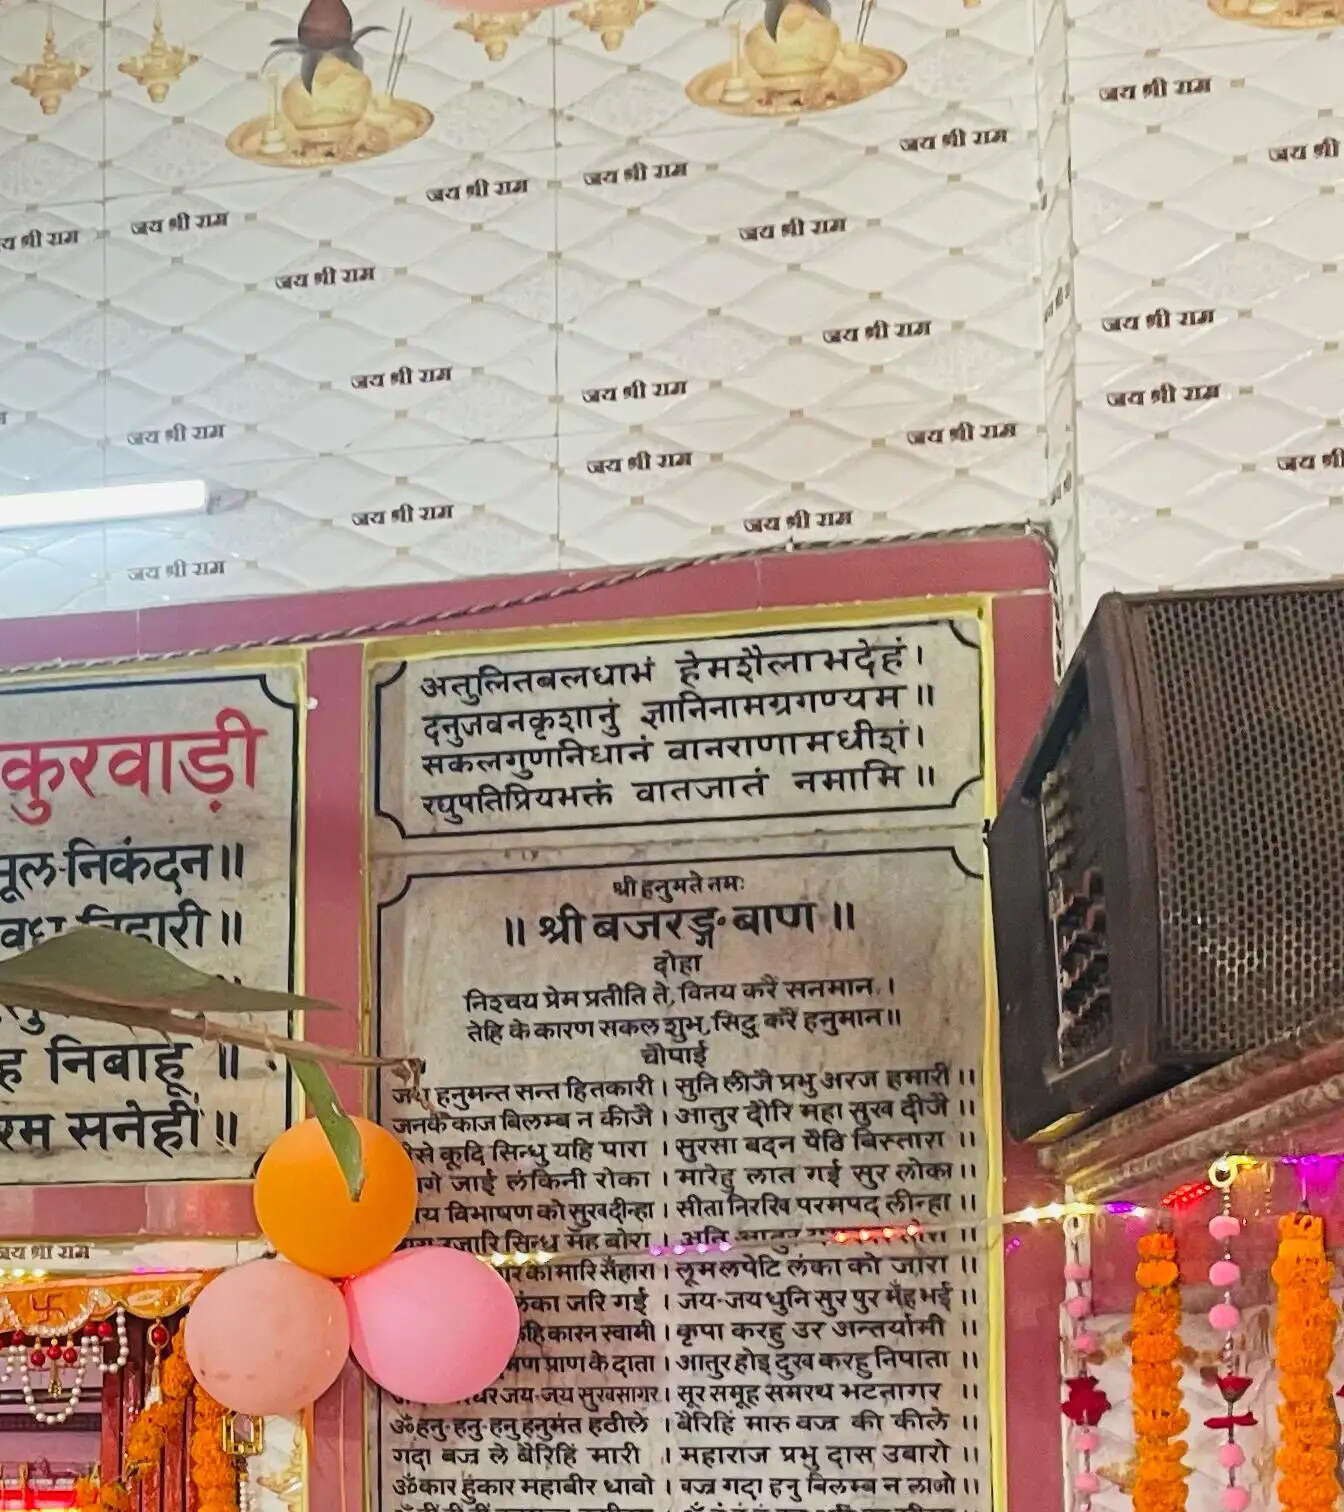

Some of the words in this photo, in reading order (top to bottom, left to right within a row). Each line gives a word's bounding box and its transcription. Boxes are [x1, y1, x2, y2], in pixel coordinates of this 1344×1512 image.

[1100, 85, 1136, 101] जय
[1143, 78, 1167, 98] श्री
[1176, 78, 1211, 94] राम
[900, 136, 936, 151] जय
[942, 129, 965, 147] श्री
[974, 129, 1007, 144] राम
[584, 170, 617, 185] जय
[624, 162, 647, 181] श्री
[654, 163, 688, 178] राम
[21, 230, 41, 247] श्री
[48, 230, 79, 246] राम
[823, 328, 859, 343] जय
[865, 320, 888, 339] श्री
[896, 321, 931, 337] राम
[1107, 391, 1145, 406] जय
[1151, 384, 1176, 403] श्री
[1183, 385, 1220, 401] राम
[792, 759, 905, 792] नमामि
[539, 903, 587, 944] श्री
[732, 903, 817, 936] बाण
[654, 950, 703, 978] दोहा
[543, 986, 579, 1009] प्रेम
[583, 982, 646, 1006] प्रतीति
[678, 980, 736, 1003] विनय
[467, 1020, 504, 1045] तेहि
[510, 1019, 530, 1040] के
[534, 1021, 594, 1040] कारण
[599, 1019, 659, 1037] सकल
[641, 1040, 708, 1068] चौपाई
[434, 1085, 510, 1111] हनुमन्त
[514, 1083, 560, 1101] सन्त
[563, 1073, 654, 1103] हितकारी
[675, 1071, 718, 1102] सुनि
[776, 1073, 818, 1098] प्रभु
[821, 1071, 879, 1089] अरज
[675, 1106, 739, 1132] आतुर
[799, 1103, 842, 1125] महा
[848, 1100, 894, 1127] सुख
[676, 1138, 737, 1163] सुरसा
[392, 1447, 430, 1471] गदा
[488, 1443, 508, 1465] ले
[586, 1442, 639, 1464] मारी
[679, 1447, 771, 1468] महाराज
[826, 1446, 876, 1469] दास
